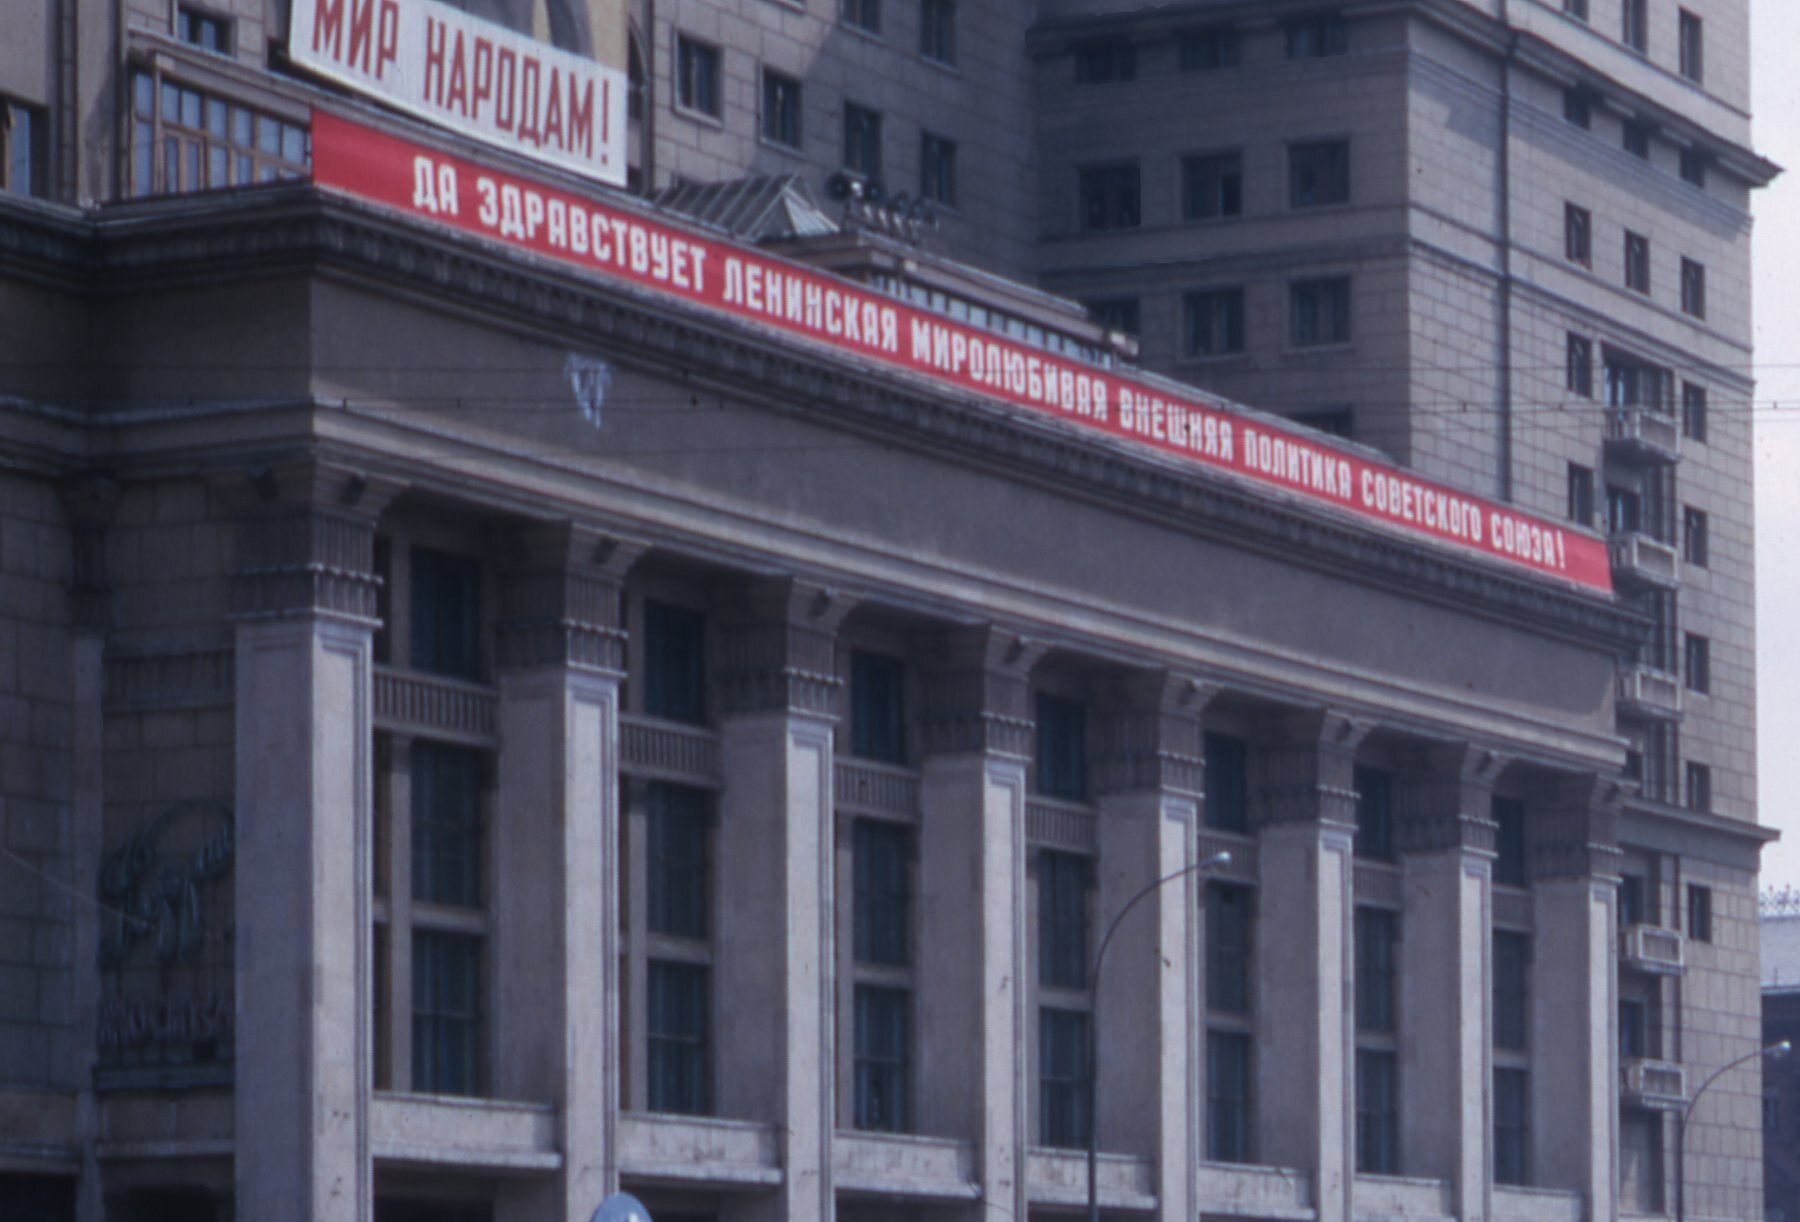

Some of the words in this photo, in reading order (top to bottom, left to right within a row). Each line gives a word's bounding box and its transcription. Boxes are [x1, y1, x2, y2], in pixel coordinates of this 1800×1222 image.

[312, 0, 399, 81] МИР
[423, 16, 610, 166] НАРОДАМ!
[413, 155, 459, 216] ДА
[476, 176, 706, 292] ЗДРАВСТВУЕТ
[723, 257, 898, 353] ЛЕНИНСКАЯ
[911, 316, 1108, 422] МИРОЛЮБИВАЯ
[1119, 387, 1234, 461] ВНЕШНЯЯ
[1244, 428, 1352, 500] ПОЛИТИКА
[1361, 468, 1482, 543] СОВЕТСКОГО
[1490, 512, 1567, 568] СОЮЗА!
